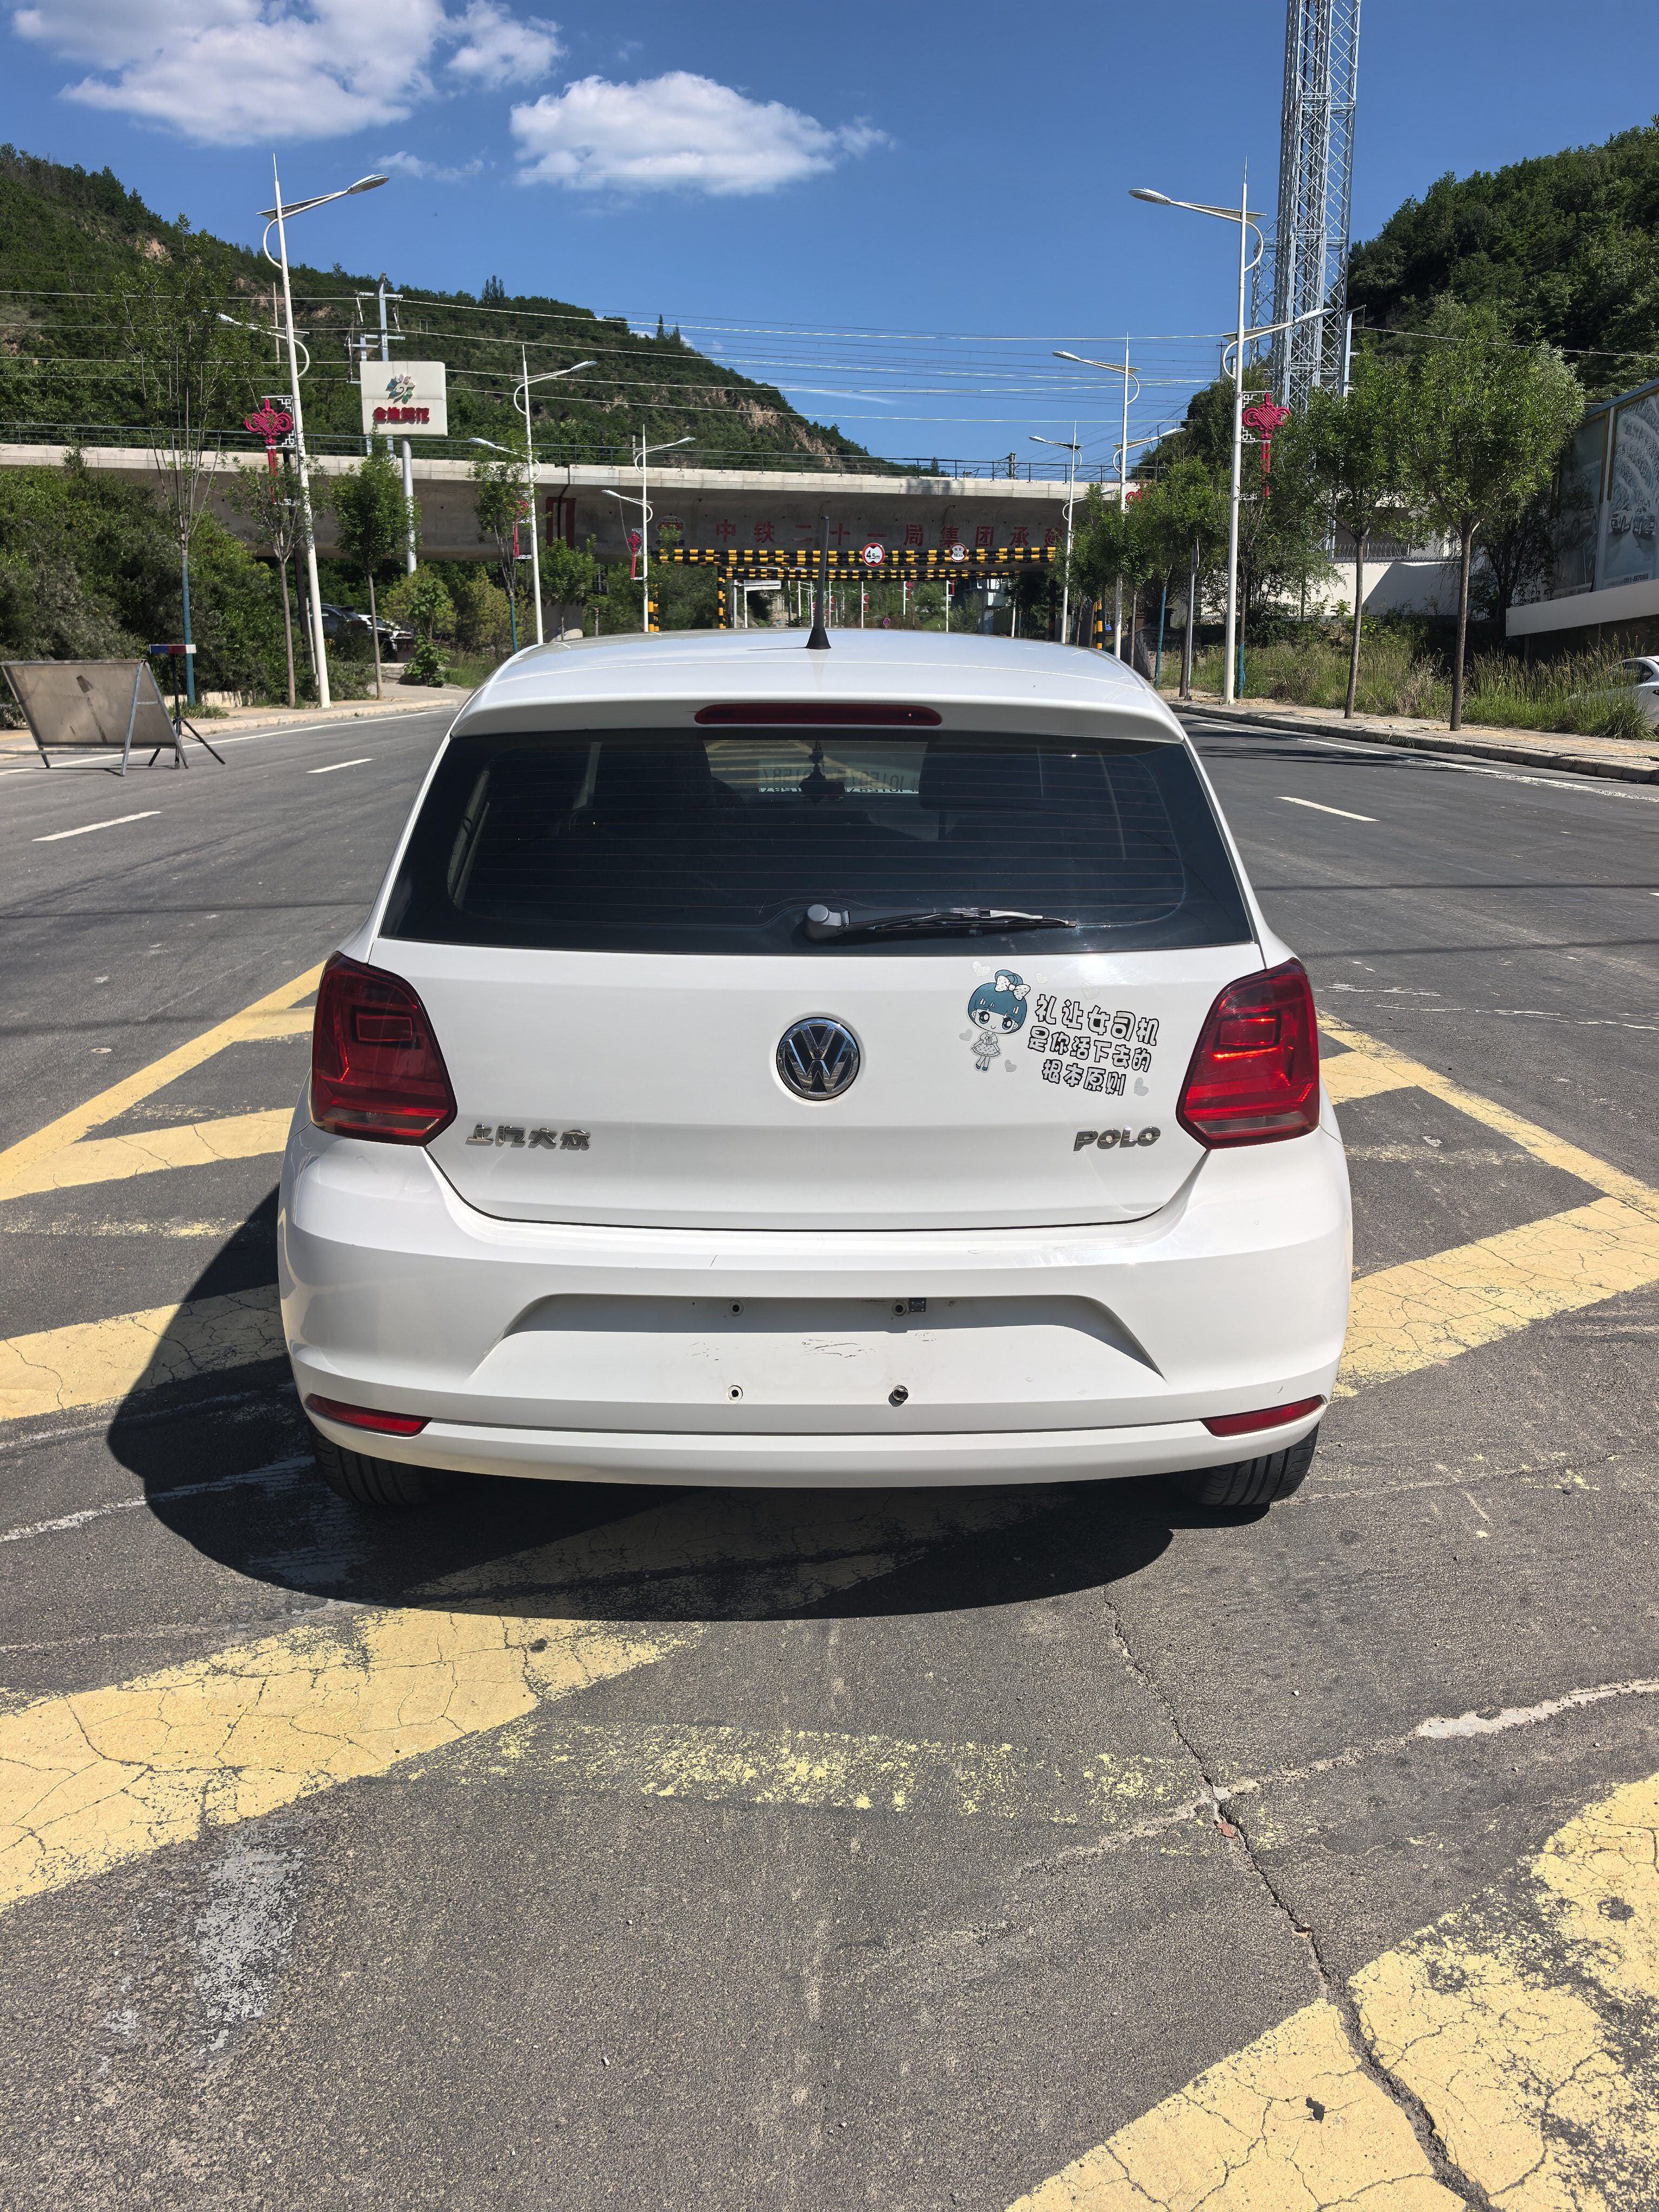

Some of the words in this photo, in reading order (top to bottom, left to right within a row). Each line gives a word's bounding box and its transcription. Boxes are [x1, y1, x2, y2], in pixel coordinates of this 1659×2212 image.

[1035, 994, 1159, 1046] 礼让女司机
[1028, 1026, 1151, 1073] 是你活下去的
[1042, 1059, 1127, 1096] 根本原则
[466, 1123, 591, 1150] 上汽大众
[1073, 1126, 1161, 1151] POLO
